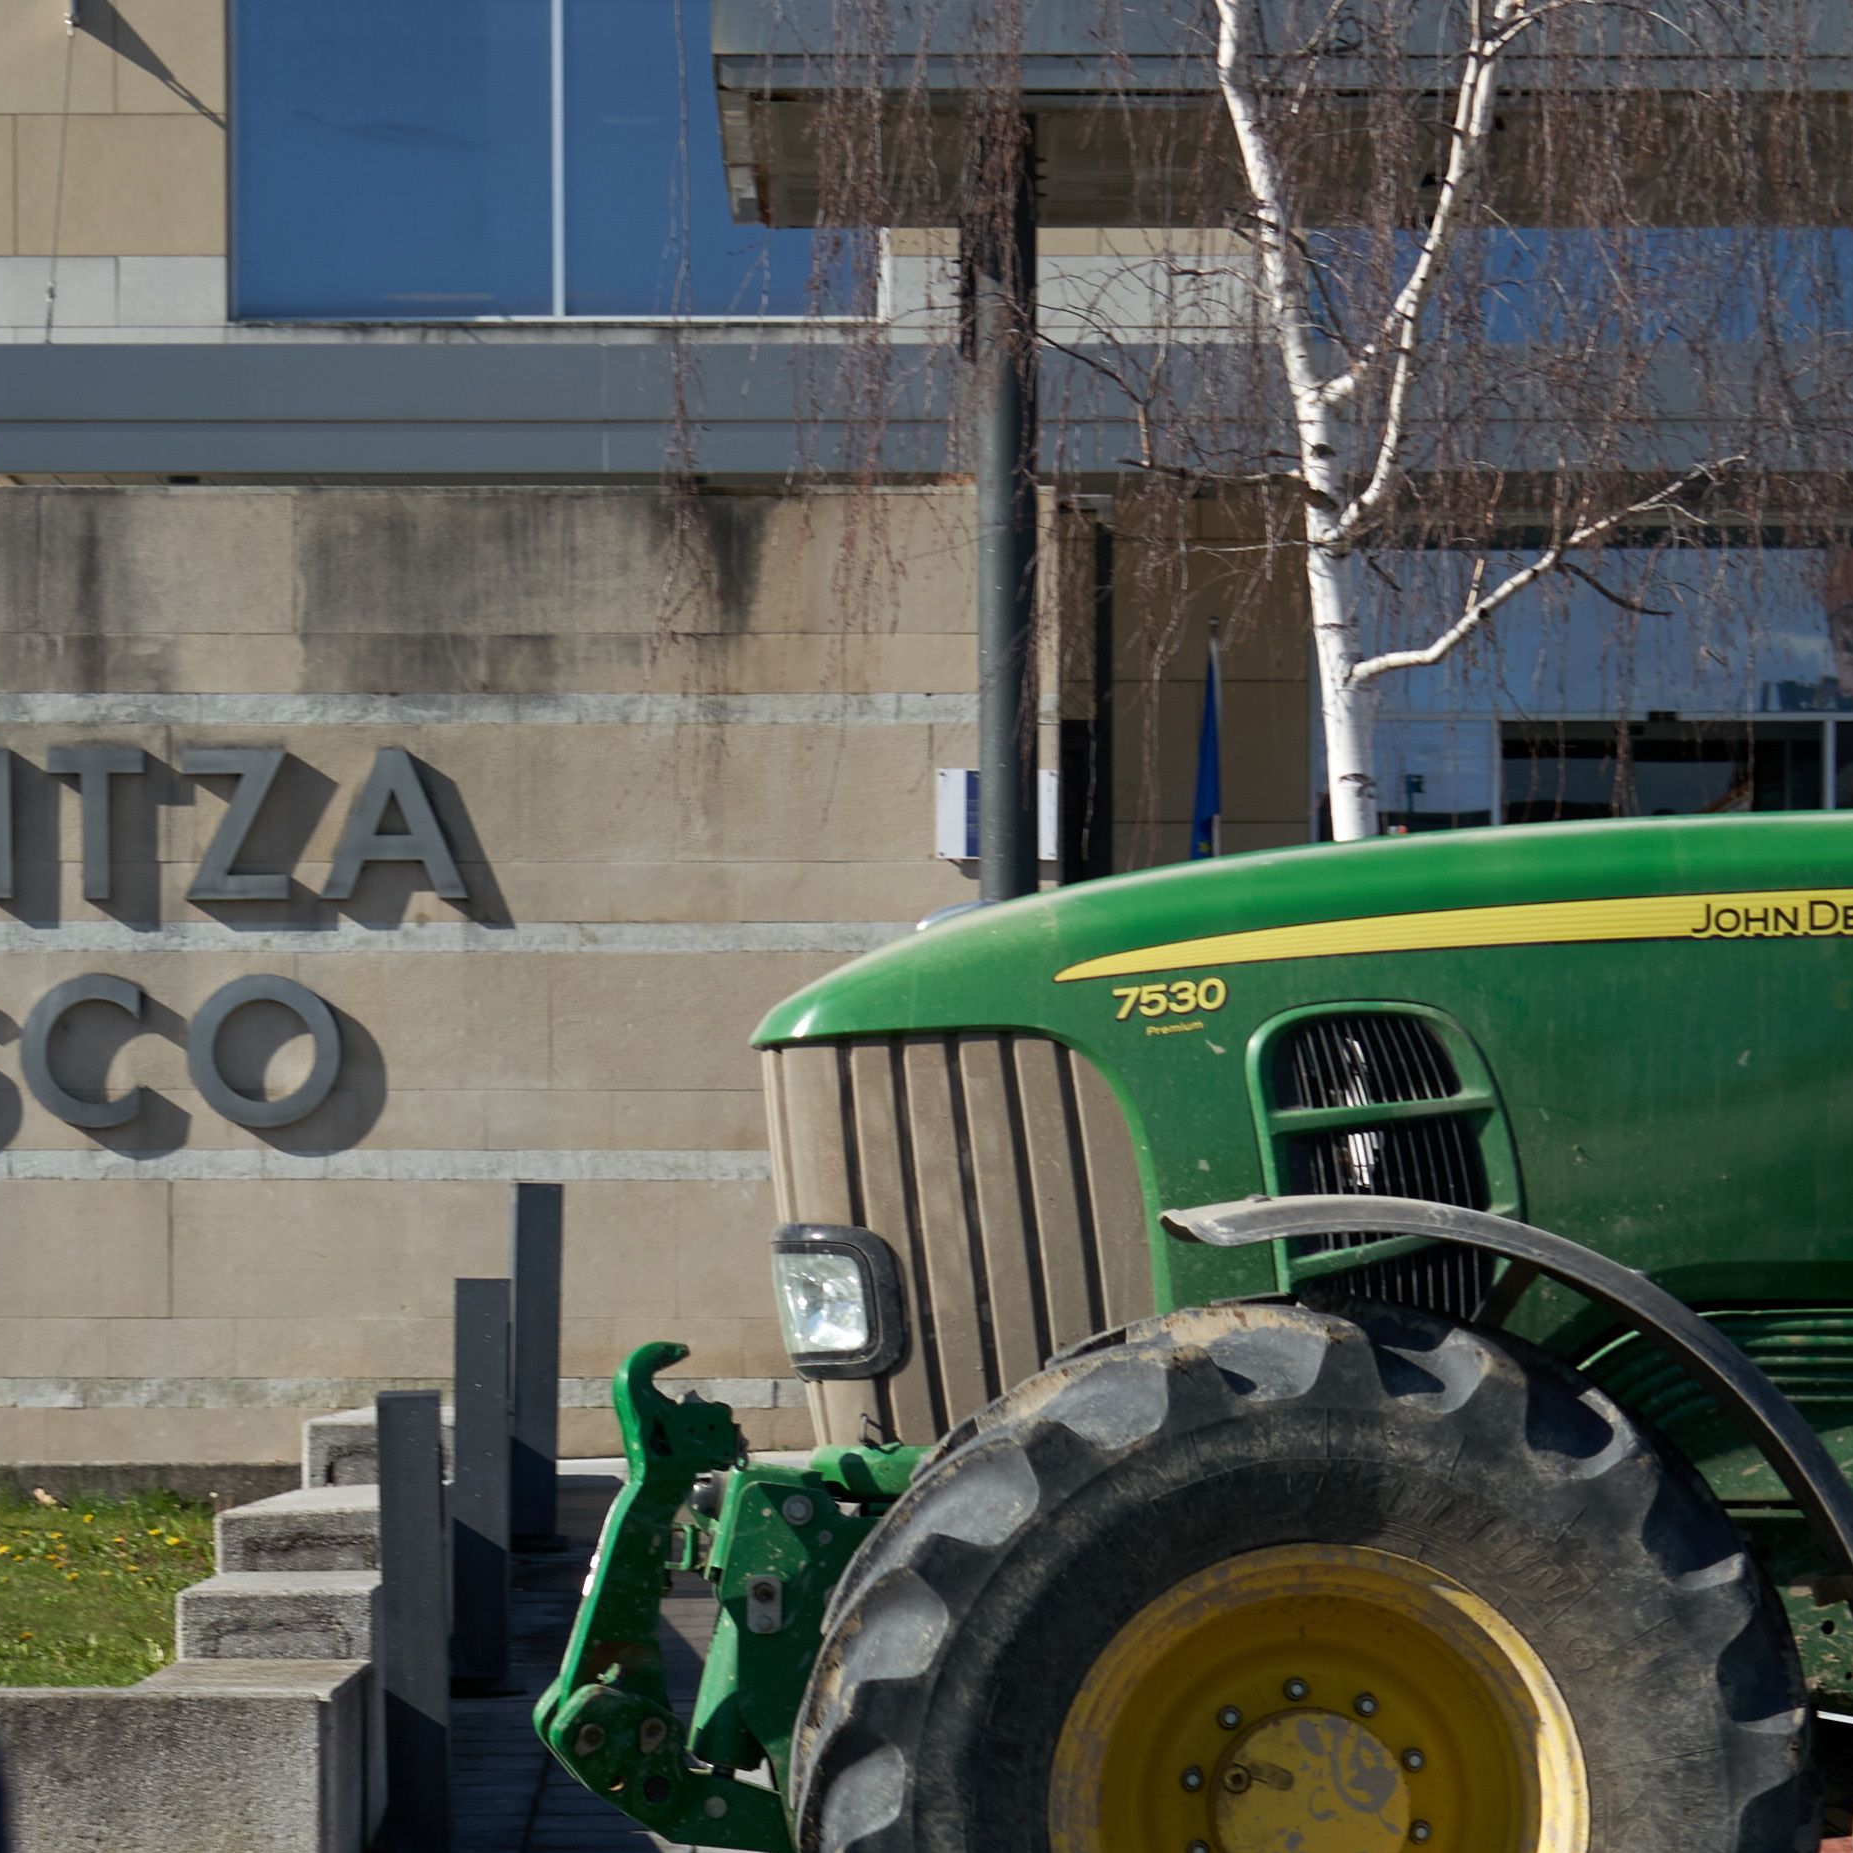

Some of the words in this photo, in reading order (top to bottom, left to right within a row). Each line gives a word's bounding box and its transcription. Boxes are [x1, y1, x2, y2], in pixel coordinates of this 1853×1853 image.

[1691, 902, 1799, 934] JOHN
[1111, 976, 1227, 1021] 7530
[1145, 1021, 1204, 1036] Premium
